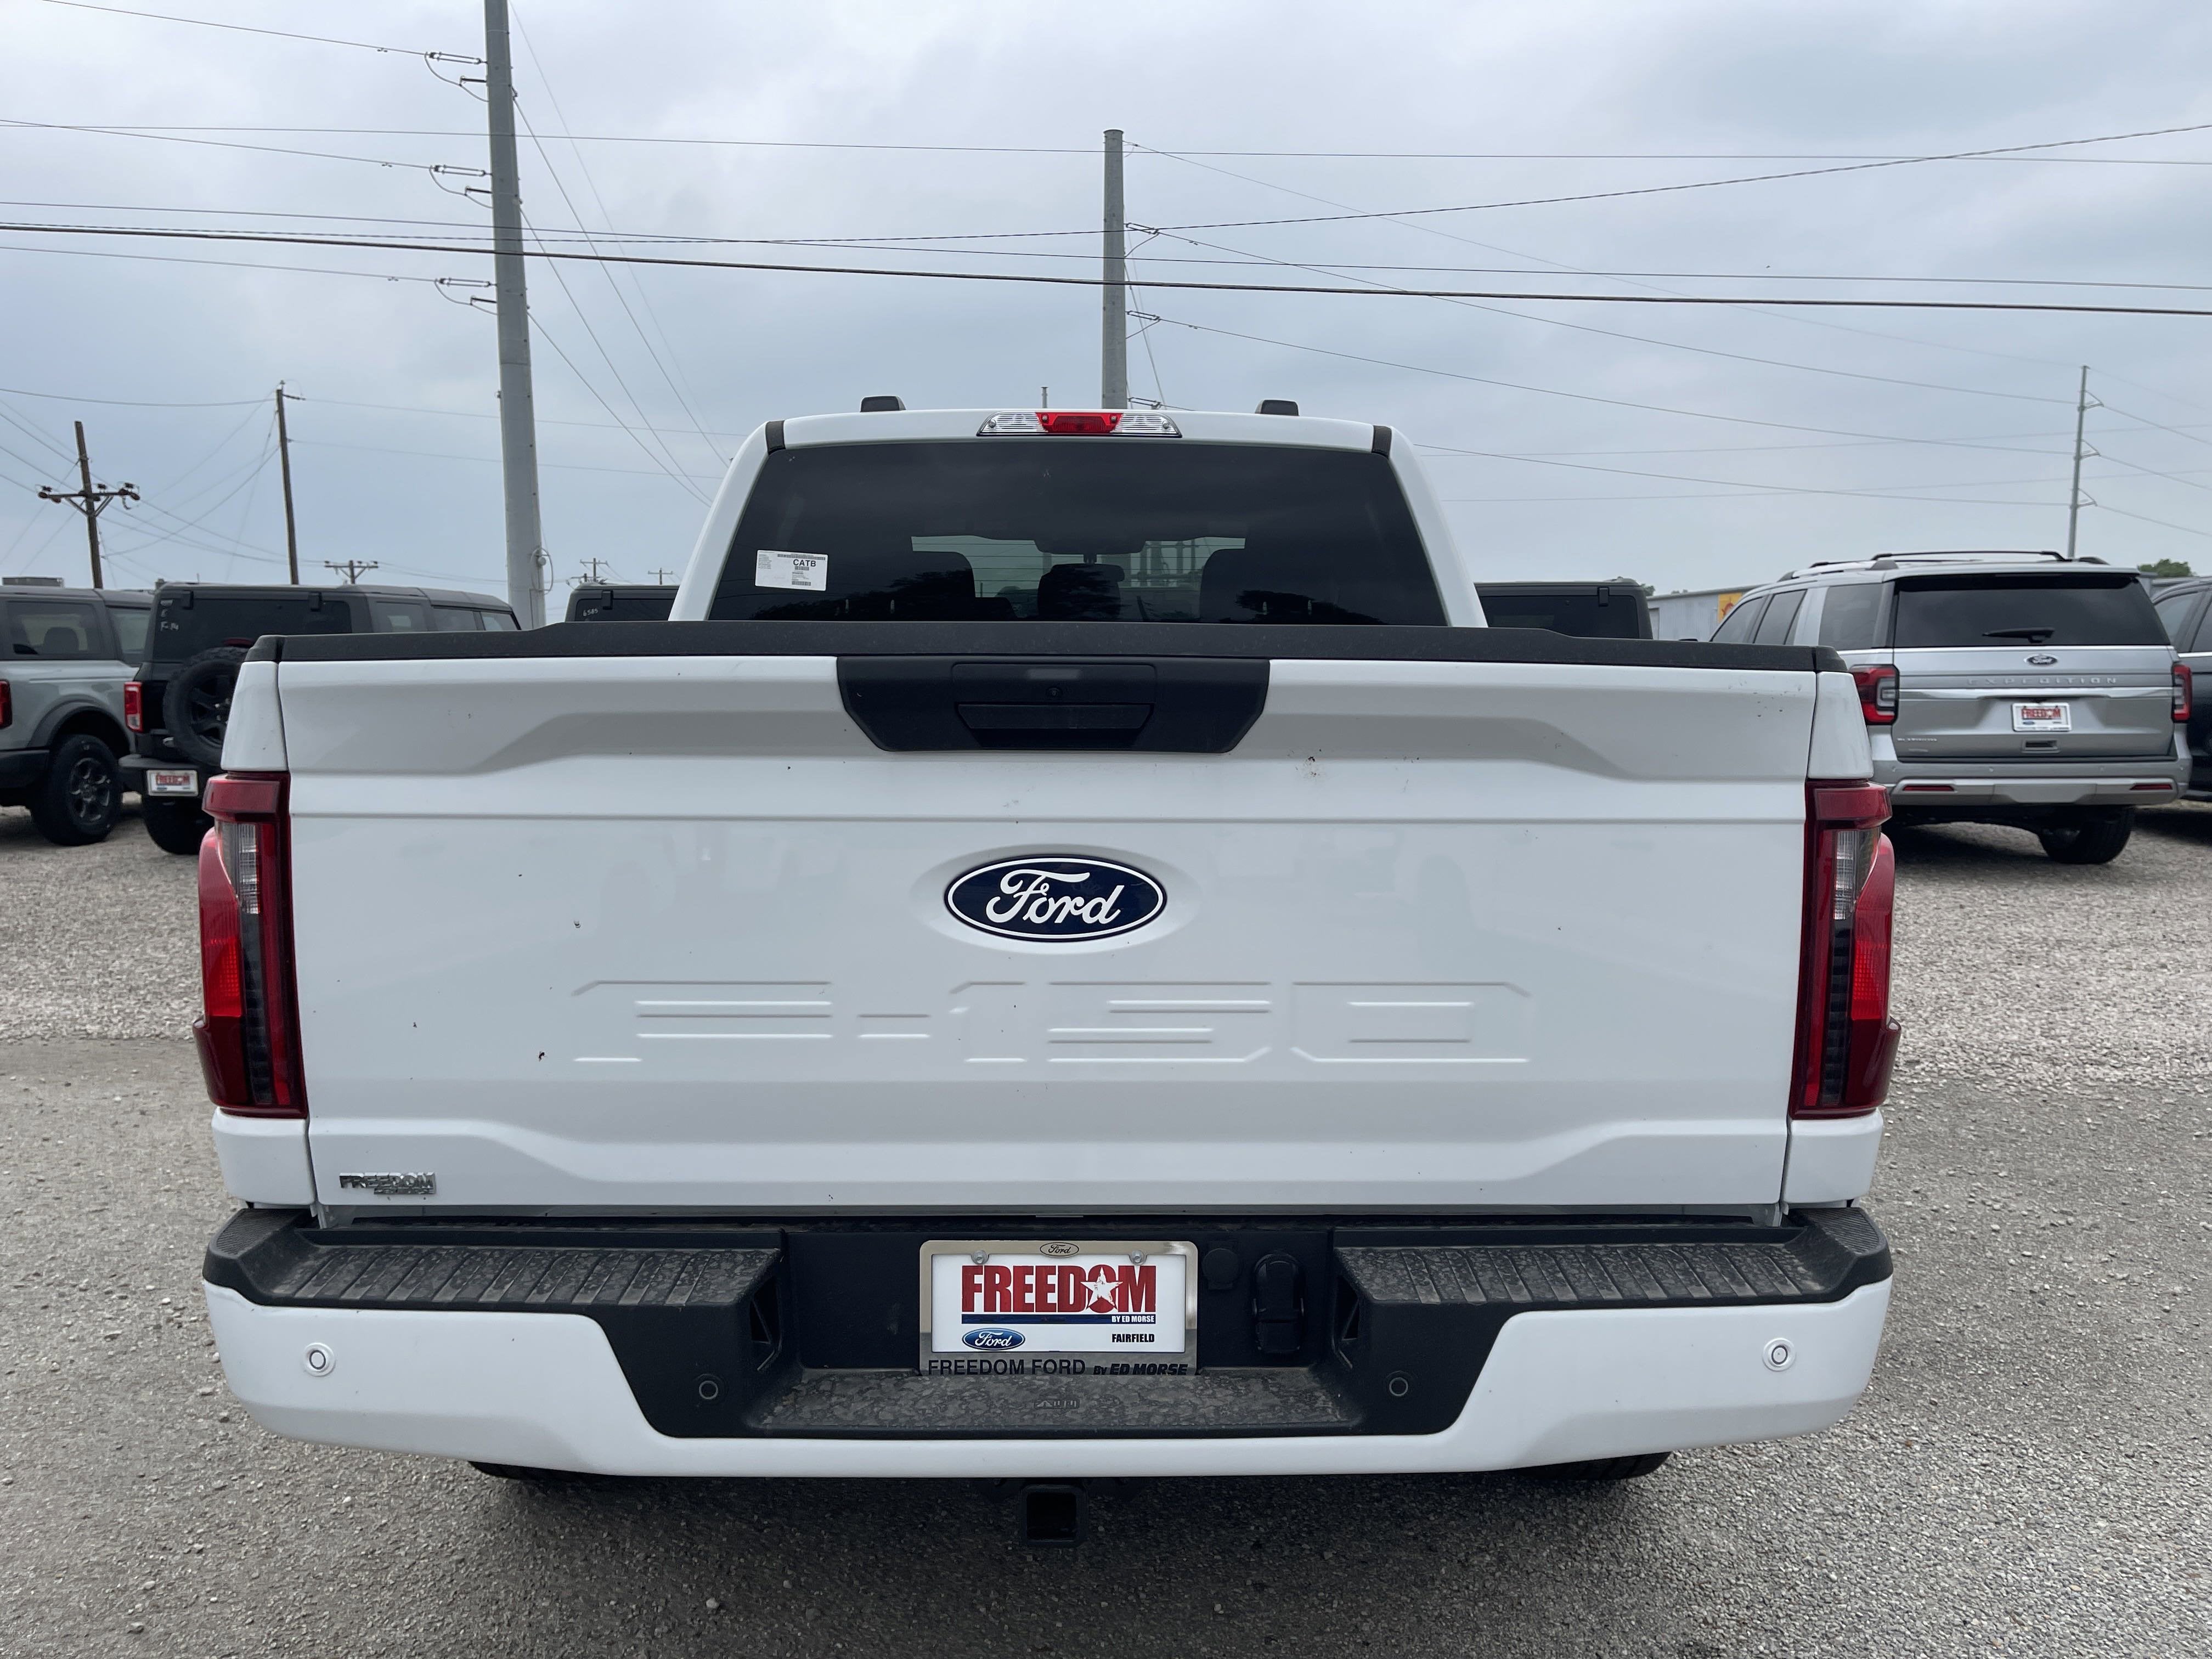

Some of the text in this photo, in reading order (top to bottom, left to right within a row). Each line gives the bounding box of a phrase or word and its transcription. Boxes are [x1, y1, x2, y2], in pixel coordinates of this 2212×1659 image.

[793, 559, 816, 567] CATB
[986, 869, 1125, 924] Ford
[1048, 1244, 1071, 1253] Ford
[961, 1264, 1156, 1313] FREEDOM
[975, 1331, 1013, 1346] Ford
[1111, 1334, 1155, 1342] FAIRFIELD
[928, 1359, 1025, 1375] FREEDOM
[1031, 1359, 1086, 1375] FORD
[1109, 1363, 1130, 1375] ED
[1132, 1363, 1188, 1375] MORSE
